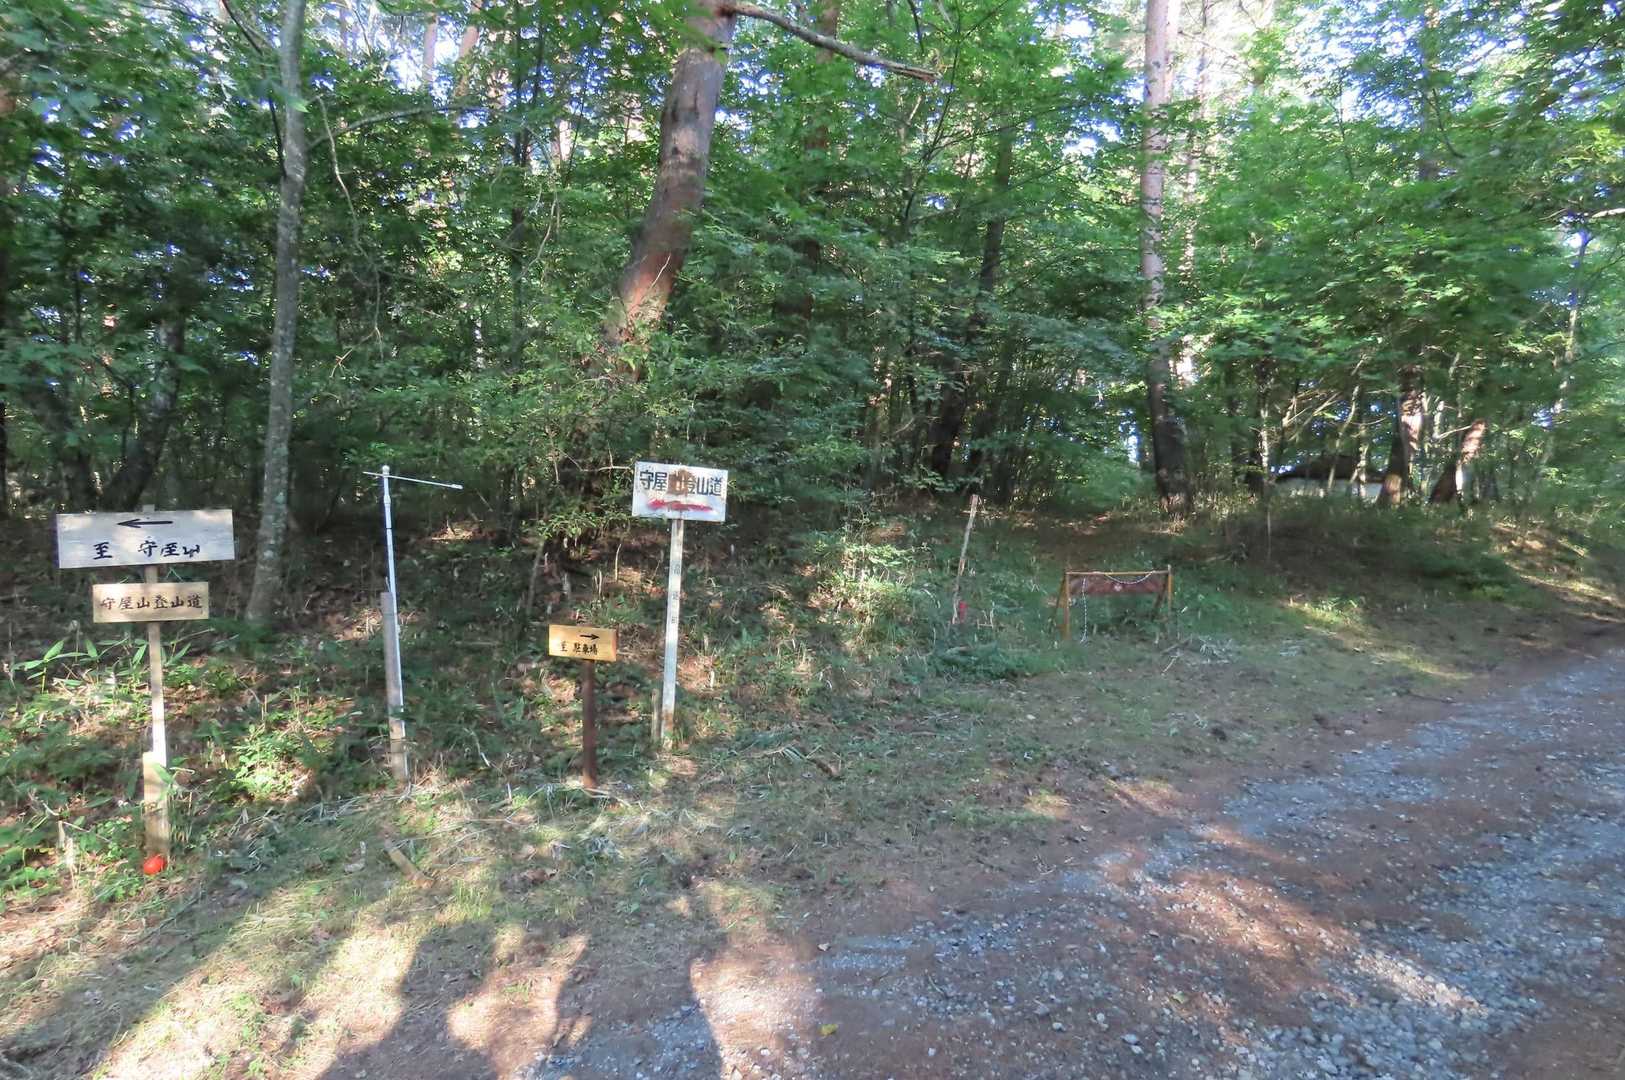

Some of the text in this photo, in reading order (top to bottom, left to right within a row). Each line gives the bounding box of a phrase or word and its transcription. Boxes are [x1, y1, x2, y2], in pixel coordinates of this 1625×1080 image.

[93, 541, 113, 560] 至
[100, 593, 203, 611] 守屋山登山道
